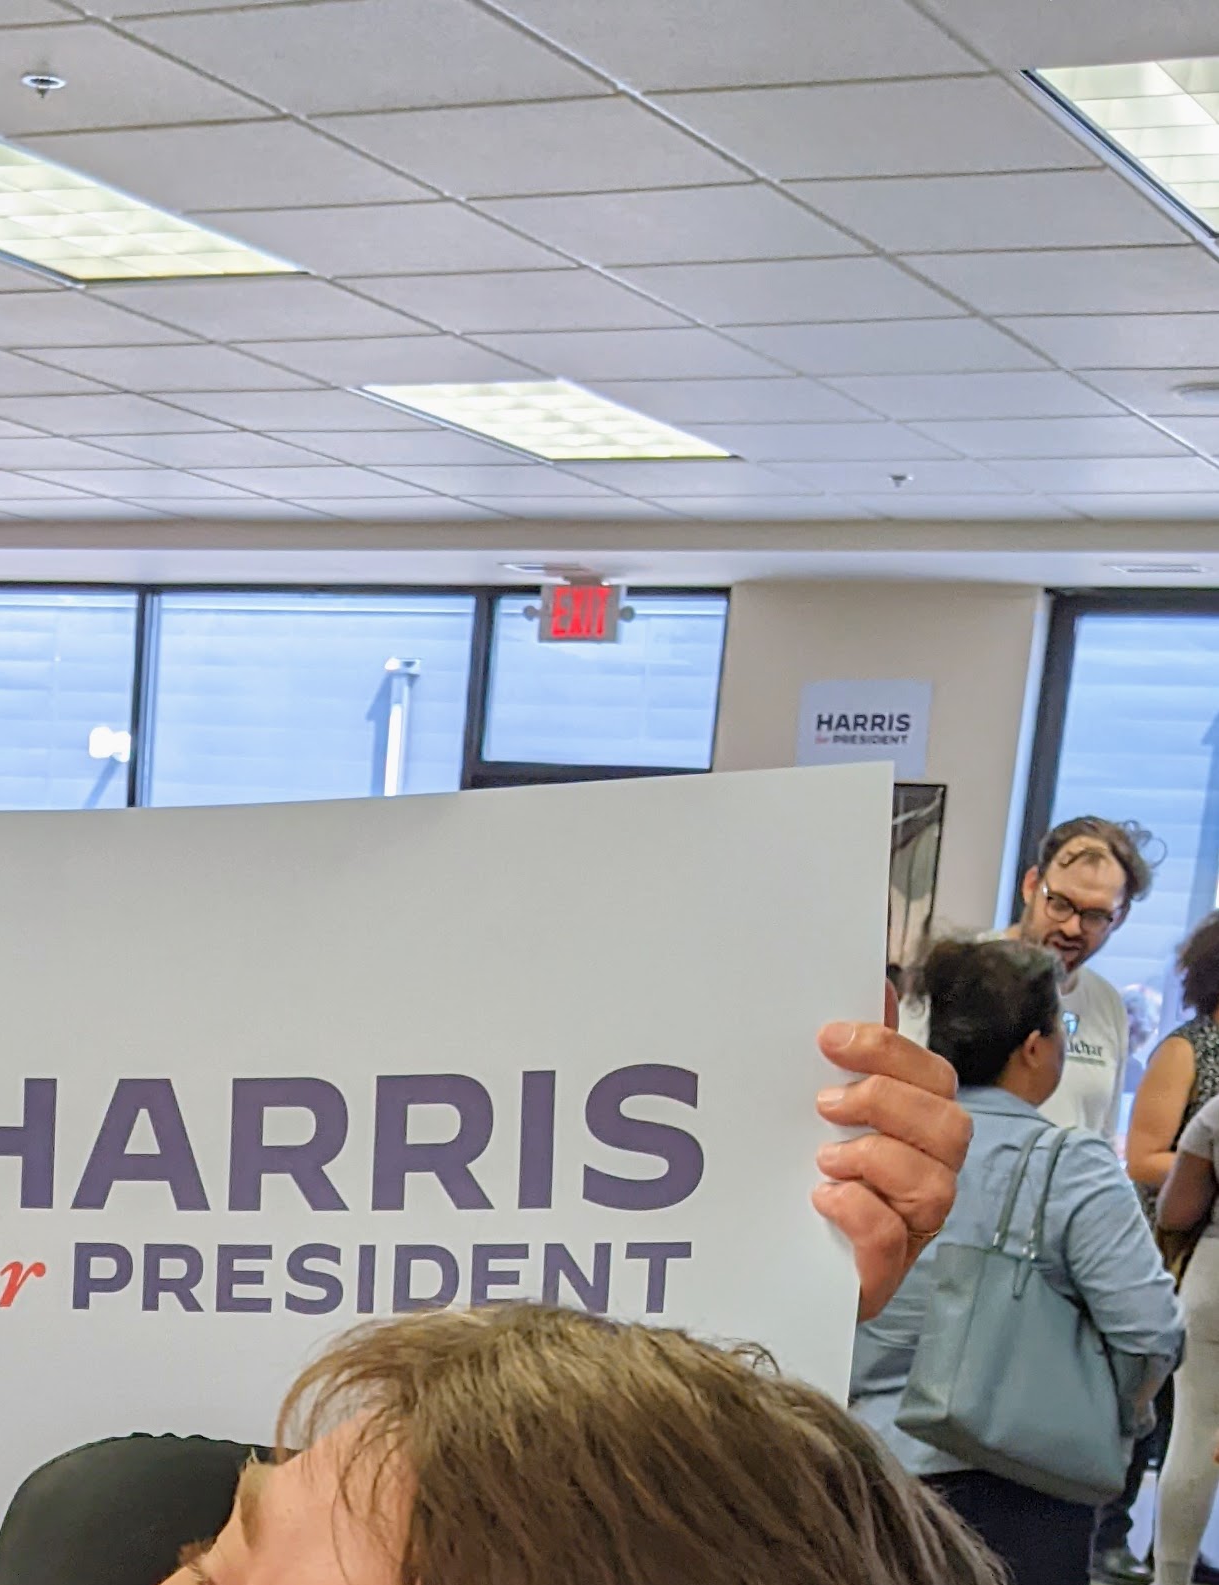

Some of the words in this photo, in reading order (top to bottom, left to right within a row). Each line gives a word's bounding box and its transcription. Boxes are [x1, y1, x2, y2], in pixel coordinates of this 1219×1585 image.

[551, 586, 612, 637] EXIT
[816, 713, 910, 732] HARRIS
[832, 734, 908, 745] PRESIDENT
[71, 1241, 693, 1316] PRESIDENT
